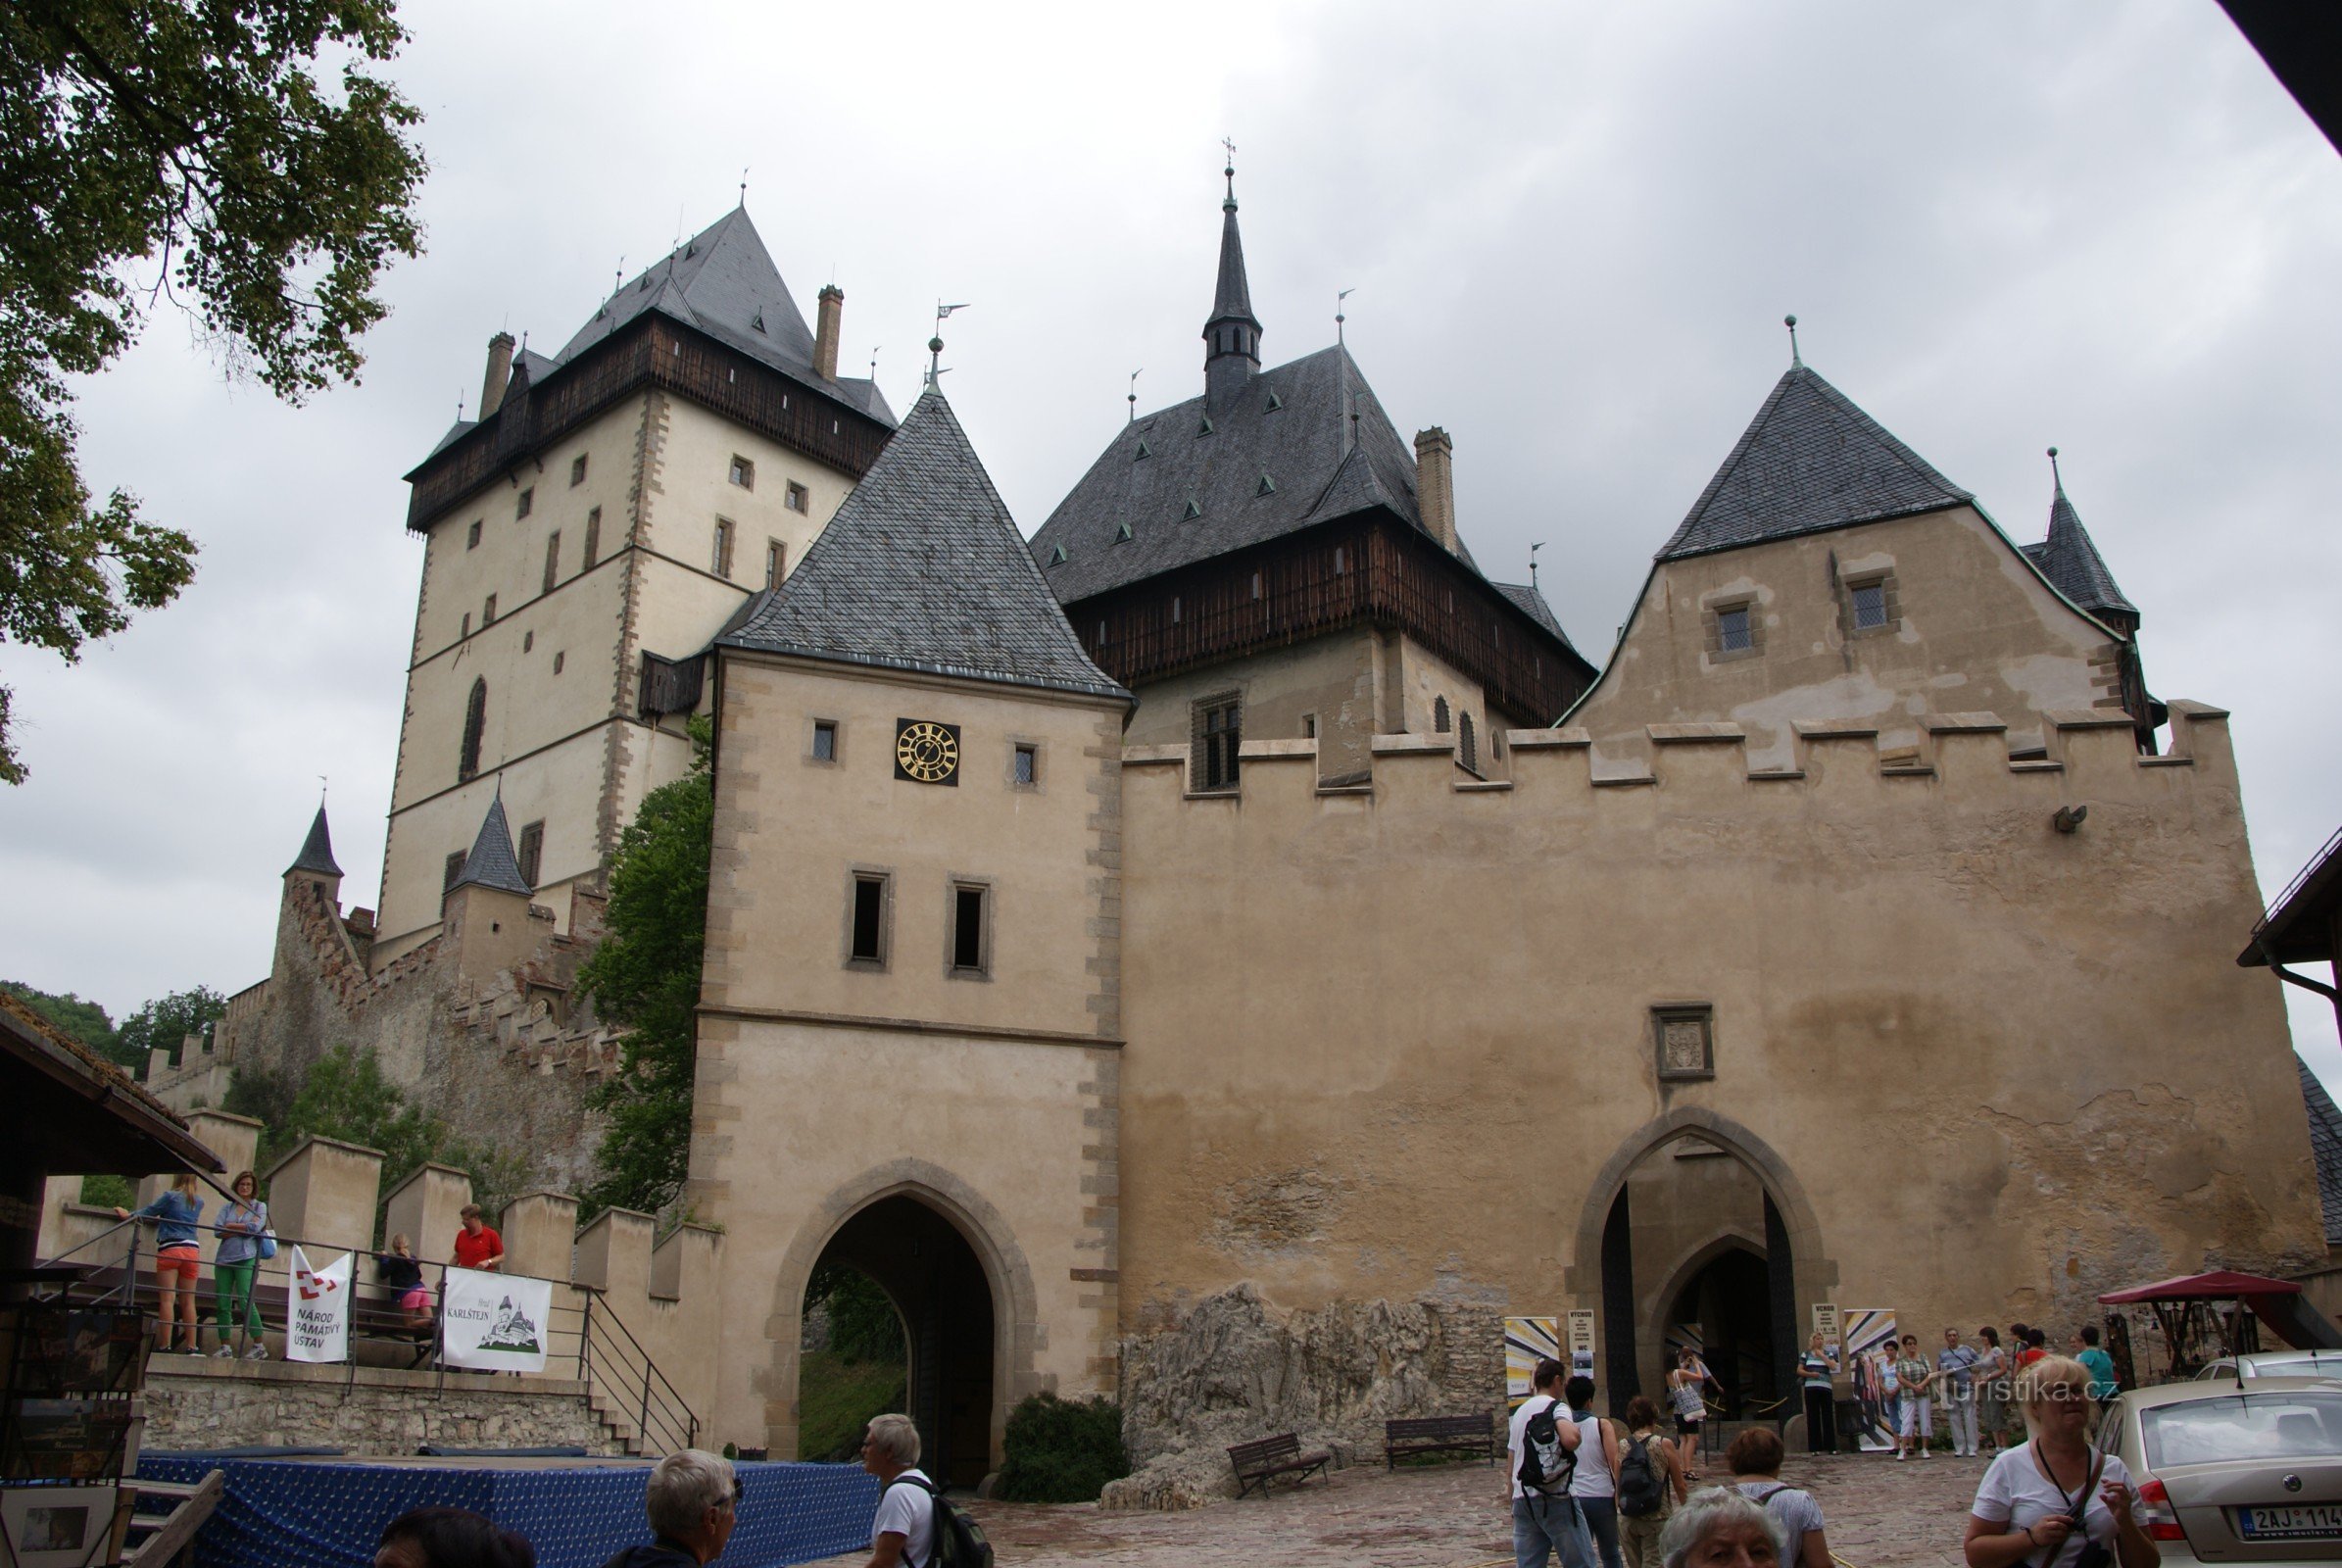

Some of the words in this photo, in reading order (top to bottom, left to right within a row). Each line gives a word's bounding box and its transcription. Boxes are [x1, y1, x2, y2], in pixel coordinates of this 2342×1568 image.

[447, 1306, 490, 1321] KARLŠTEJN
[2256, 1509, 2292, 1529] 2AJ
[2306, 1507, 2342, 1528] 114
